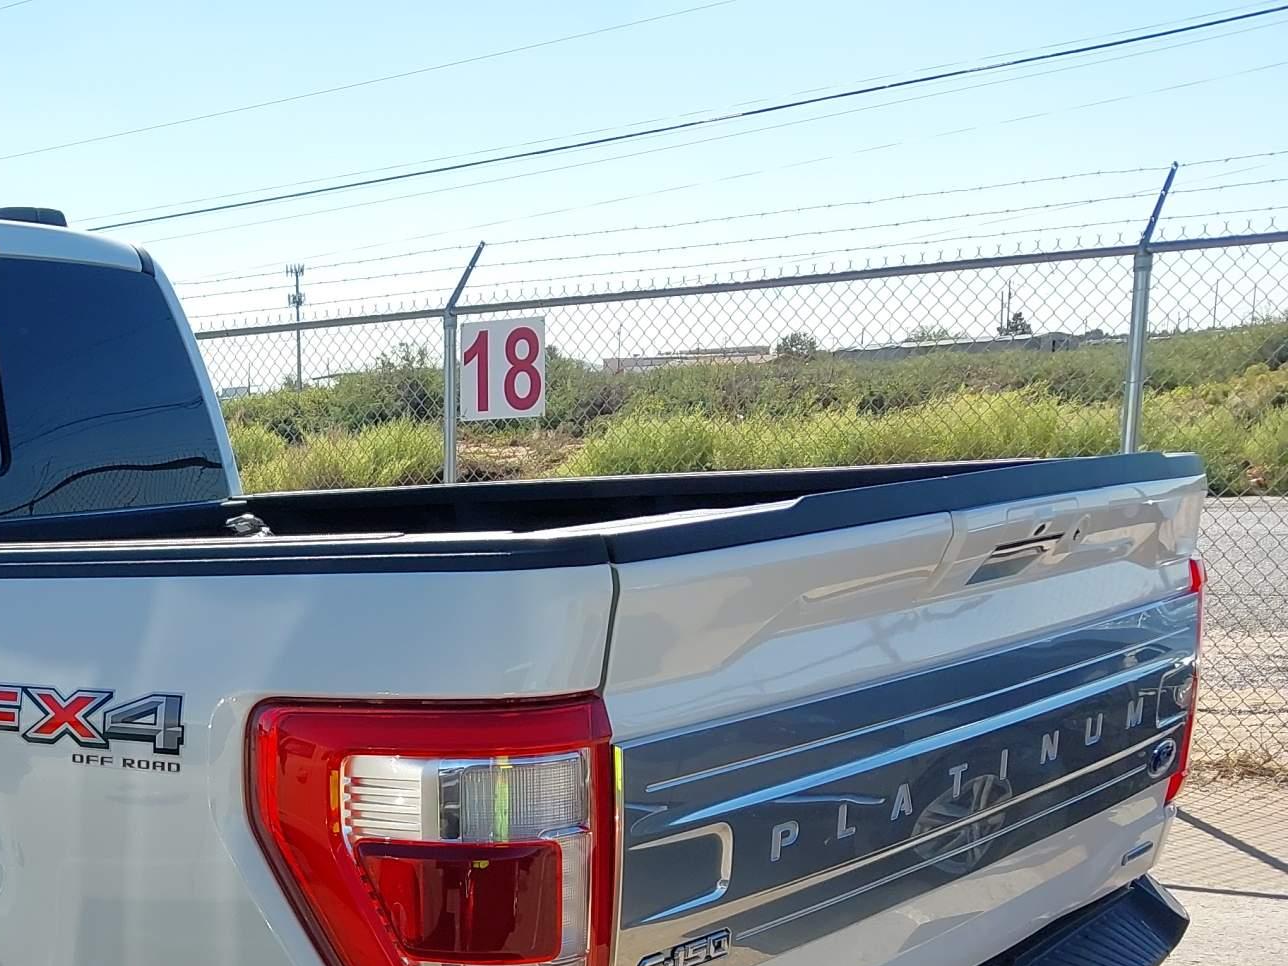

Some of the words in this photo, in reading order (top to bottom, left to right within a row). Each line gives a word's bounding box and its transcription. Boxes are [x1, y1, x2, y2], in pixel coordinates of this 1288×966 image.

[463, 326, 542, 413] 18
[72, 753, 113, 766] OFF
[121, 758, 181, 773] ROAD
[770, 698, 1144, 862] PLATINUM
